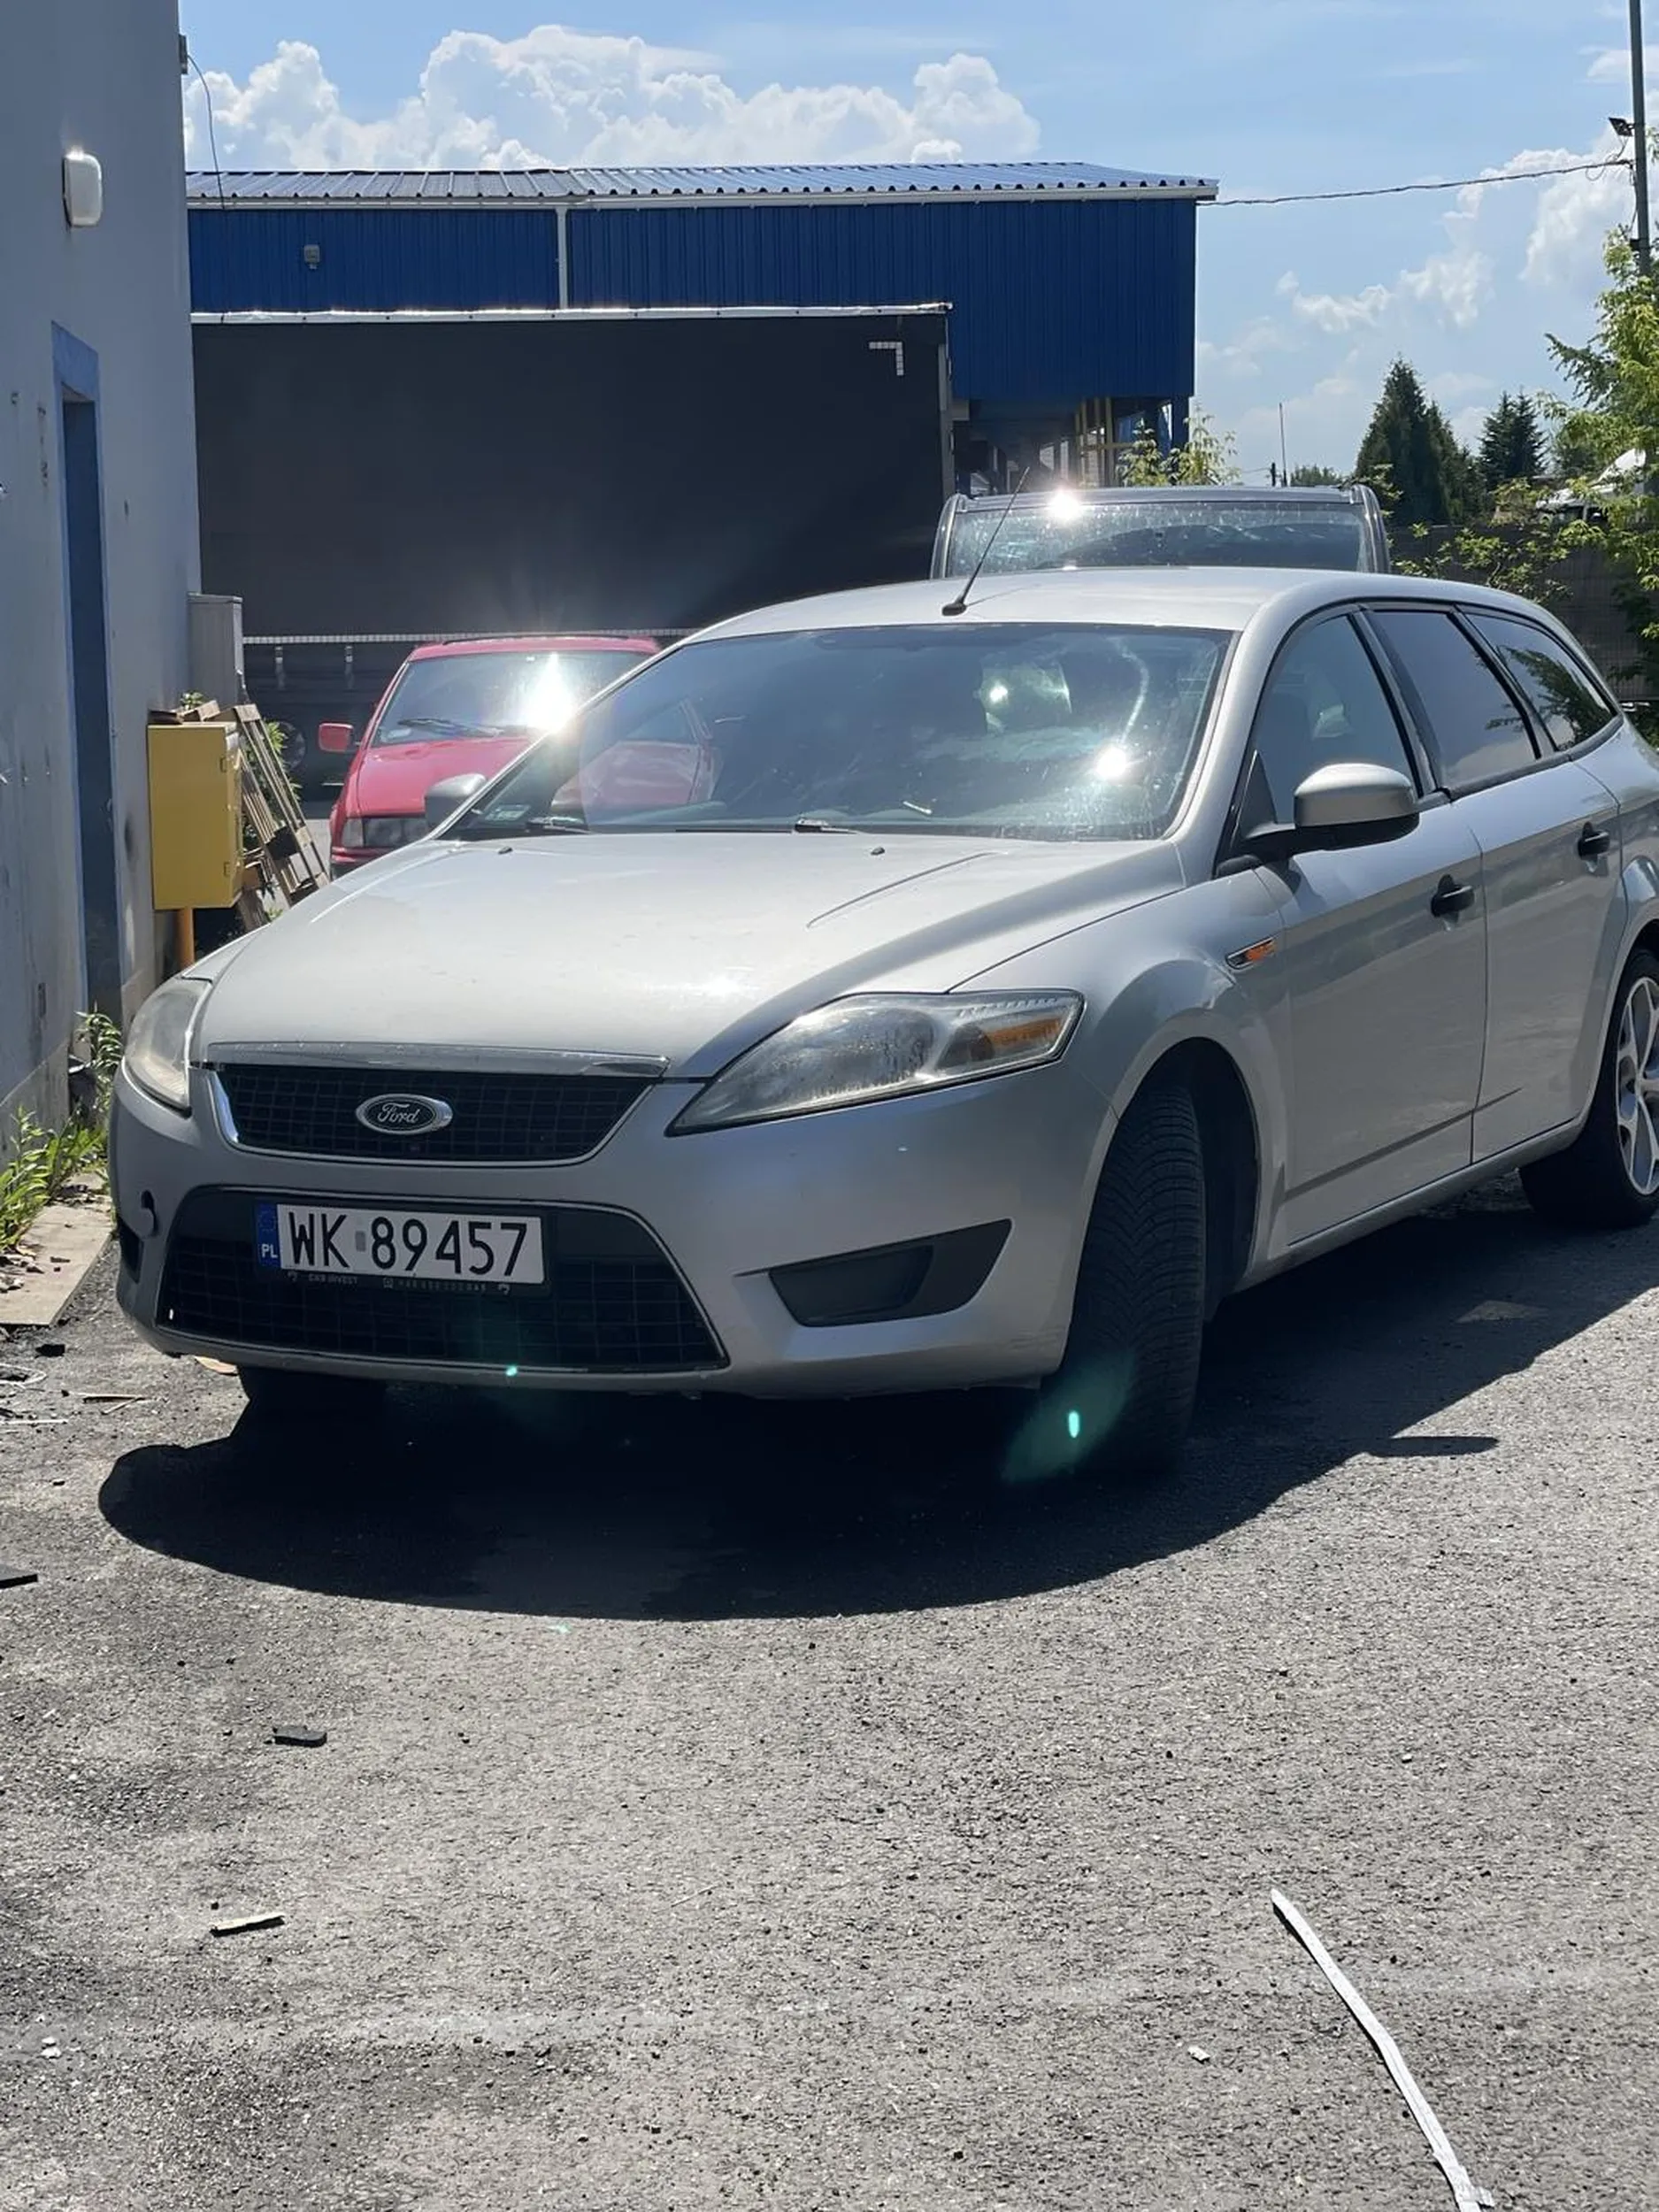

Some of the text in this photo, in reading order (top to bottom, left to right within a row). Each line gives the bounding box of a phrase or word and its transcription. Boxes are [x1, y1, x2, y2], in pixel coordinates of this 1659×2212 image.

[377, 1102, 420, 1124] Ford
[261, 1243, 279, 1259] PL
[288, 1211, 528, 1277] WK 89457
